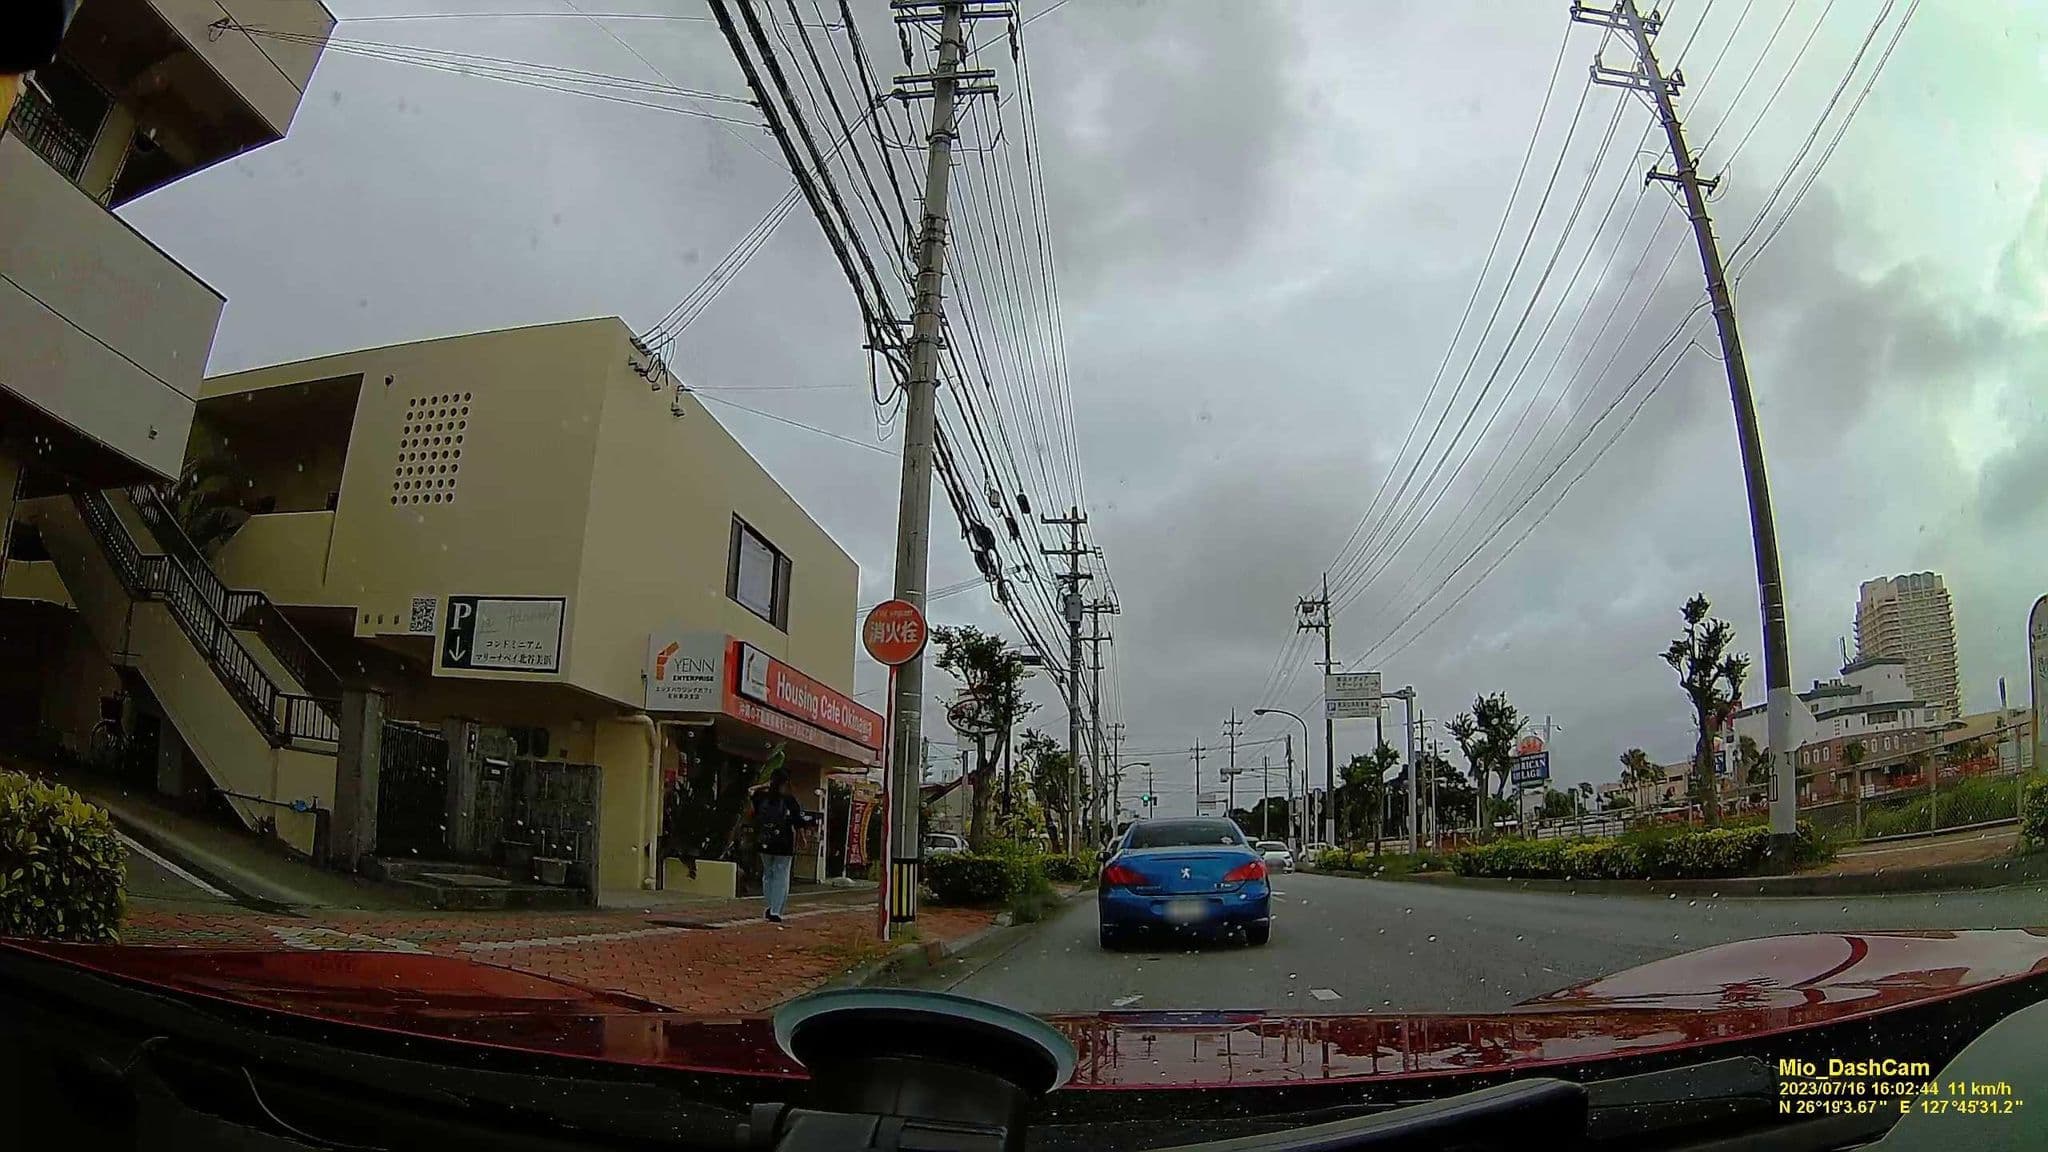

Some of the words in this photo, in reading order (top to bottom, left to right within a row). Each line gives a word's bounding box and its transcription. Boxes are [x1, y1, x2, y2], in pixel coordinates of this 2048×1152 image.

[451, 602, 472, 630] P
[871, 620, 919, 643] 消火栓
[485, 639, 543, 650] コンドミニアム
[674, 658, 715, 673] YENN
[776, 671, 818, 719] Housing
[820, 694, 841, 724] Cafe
